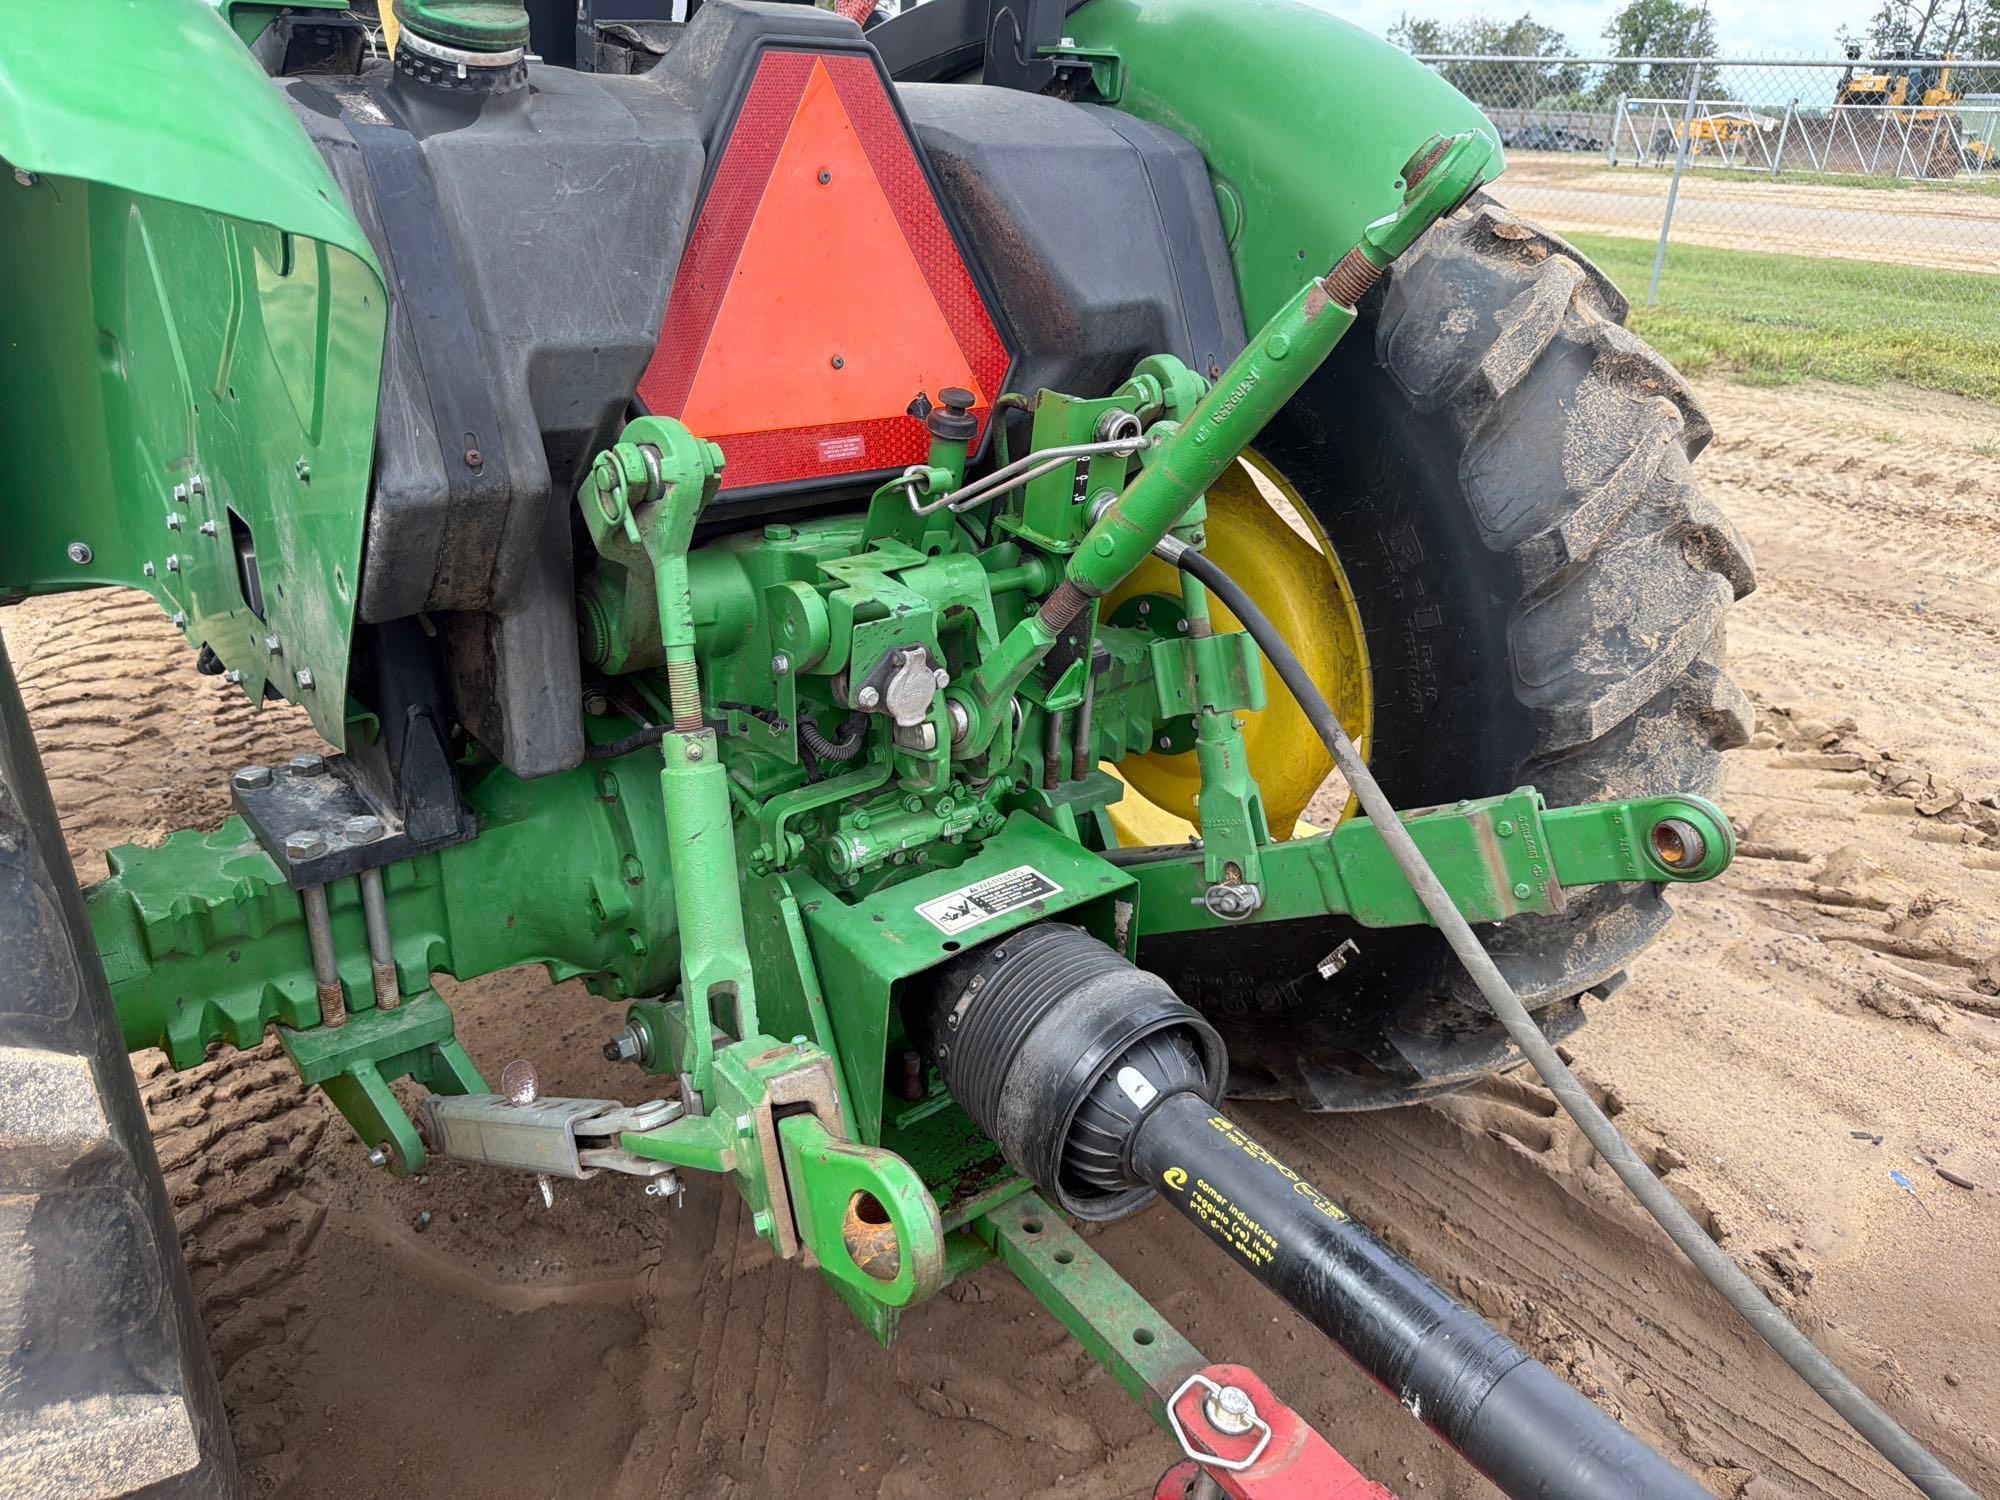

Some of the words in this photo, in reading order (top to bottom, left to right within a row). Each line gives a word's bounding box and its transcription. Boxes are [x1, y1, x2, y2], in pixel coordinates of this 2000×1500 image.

[977, 870, 1024, 890] WARNING
[1190, 1200, 1208, 1219] PTO
[1210, 1219, 1233, 1242] drive
[1235, 1241, 1261, 1266] shaft
[1192, 1190, 1230, 1225] reggiolo
[1231, 1221, 1250, 1243] (re)
[1252, 1239, 1274, 1262] italy
[1197, 1179, 1228, 1205] comer
[1228, 1202, 1278, 1249] industries
